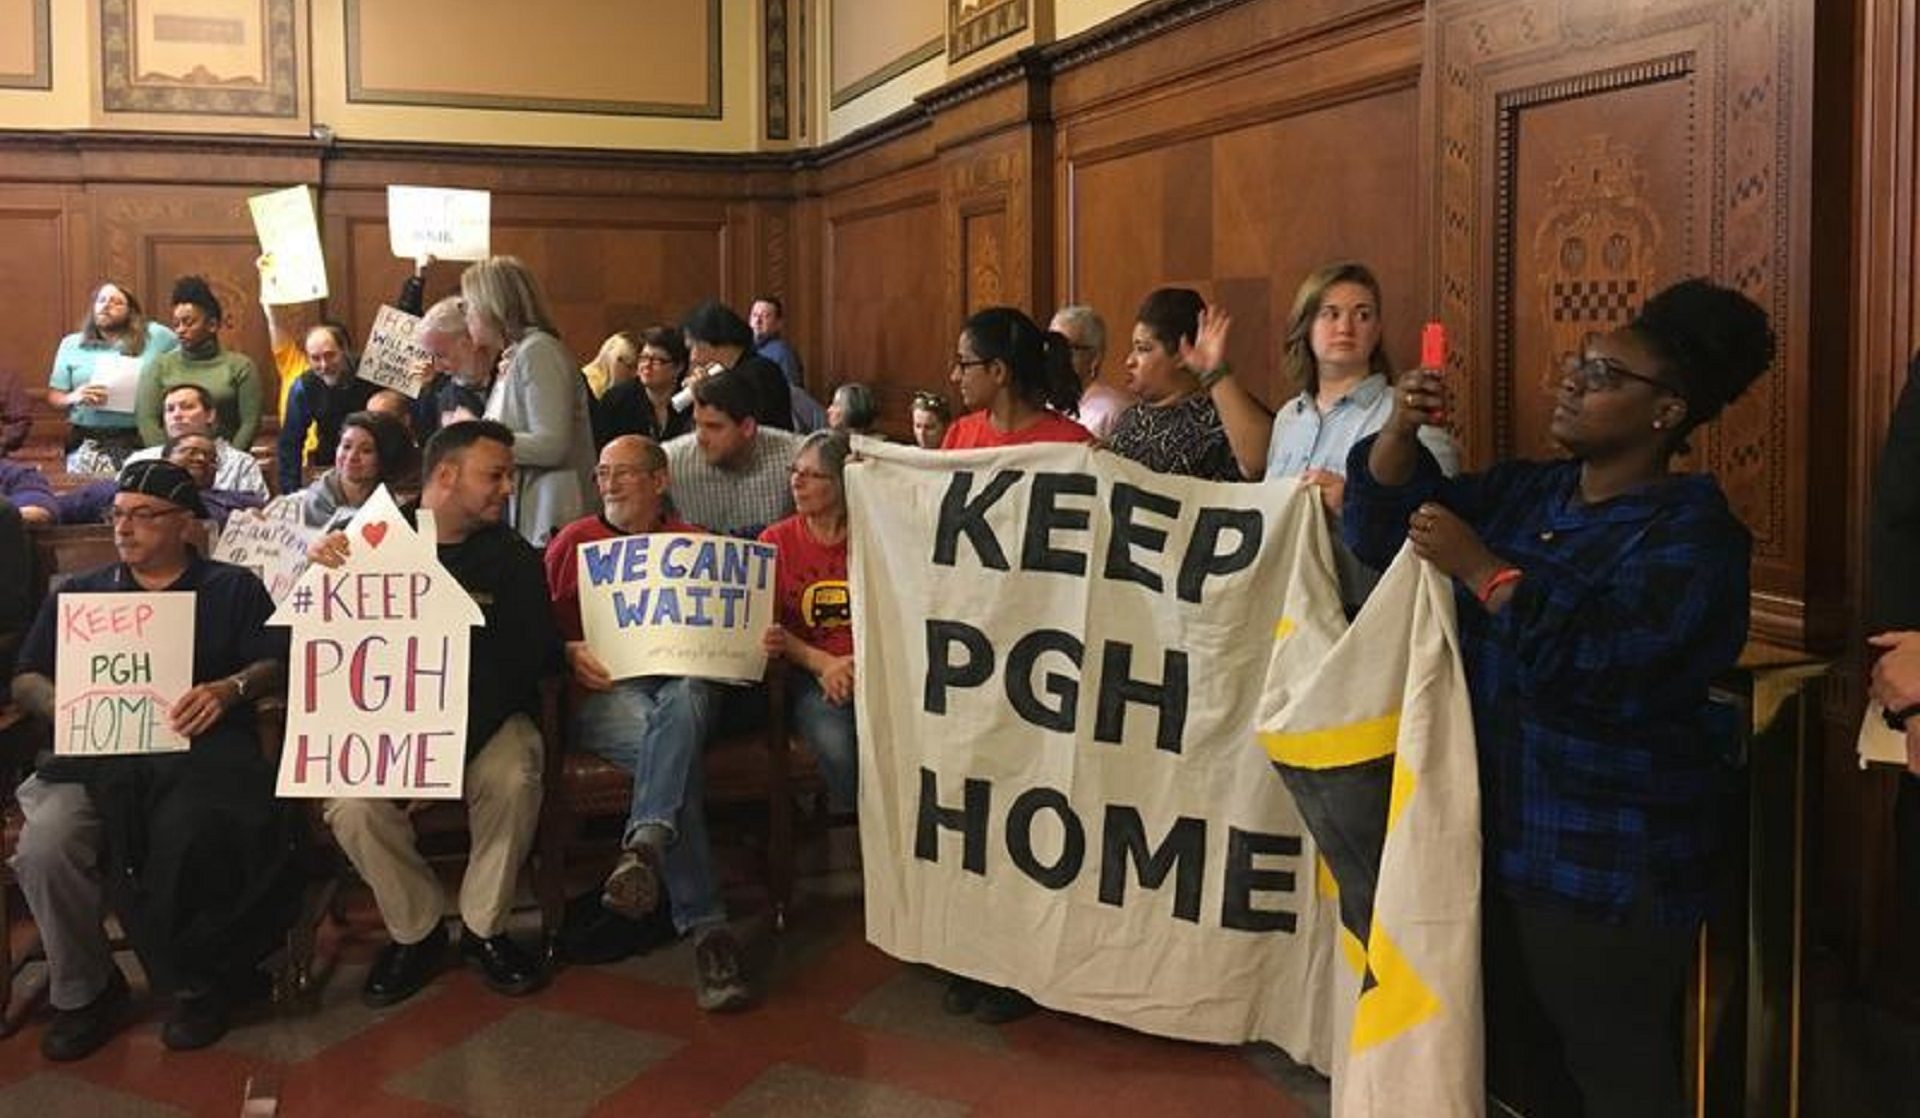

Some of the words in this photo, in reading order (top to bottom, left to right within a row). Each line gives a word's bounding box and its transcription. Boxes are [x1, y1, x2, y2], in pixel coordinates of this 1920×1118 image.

[583, 538, 649, 586] WE
[932, 470, 1263, 603] KEEP
[64, 603, 153, 642] KEEP
[293, 573, 431, 621] #KEEP
[613, 589, 749, 630] WAIT!
[91, 653, 152, 684] PGH
[304, 635, 449, 714] PGH
[922, 619, 1189, 754] PGH
[70, 696, 170, 752] HOME
[294, 732, 455, 788] HOME
[914, 767, 1301, 934] HOME
